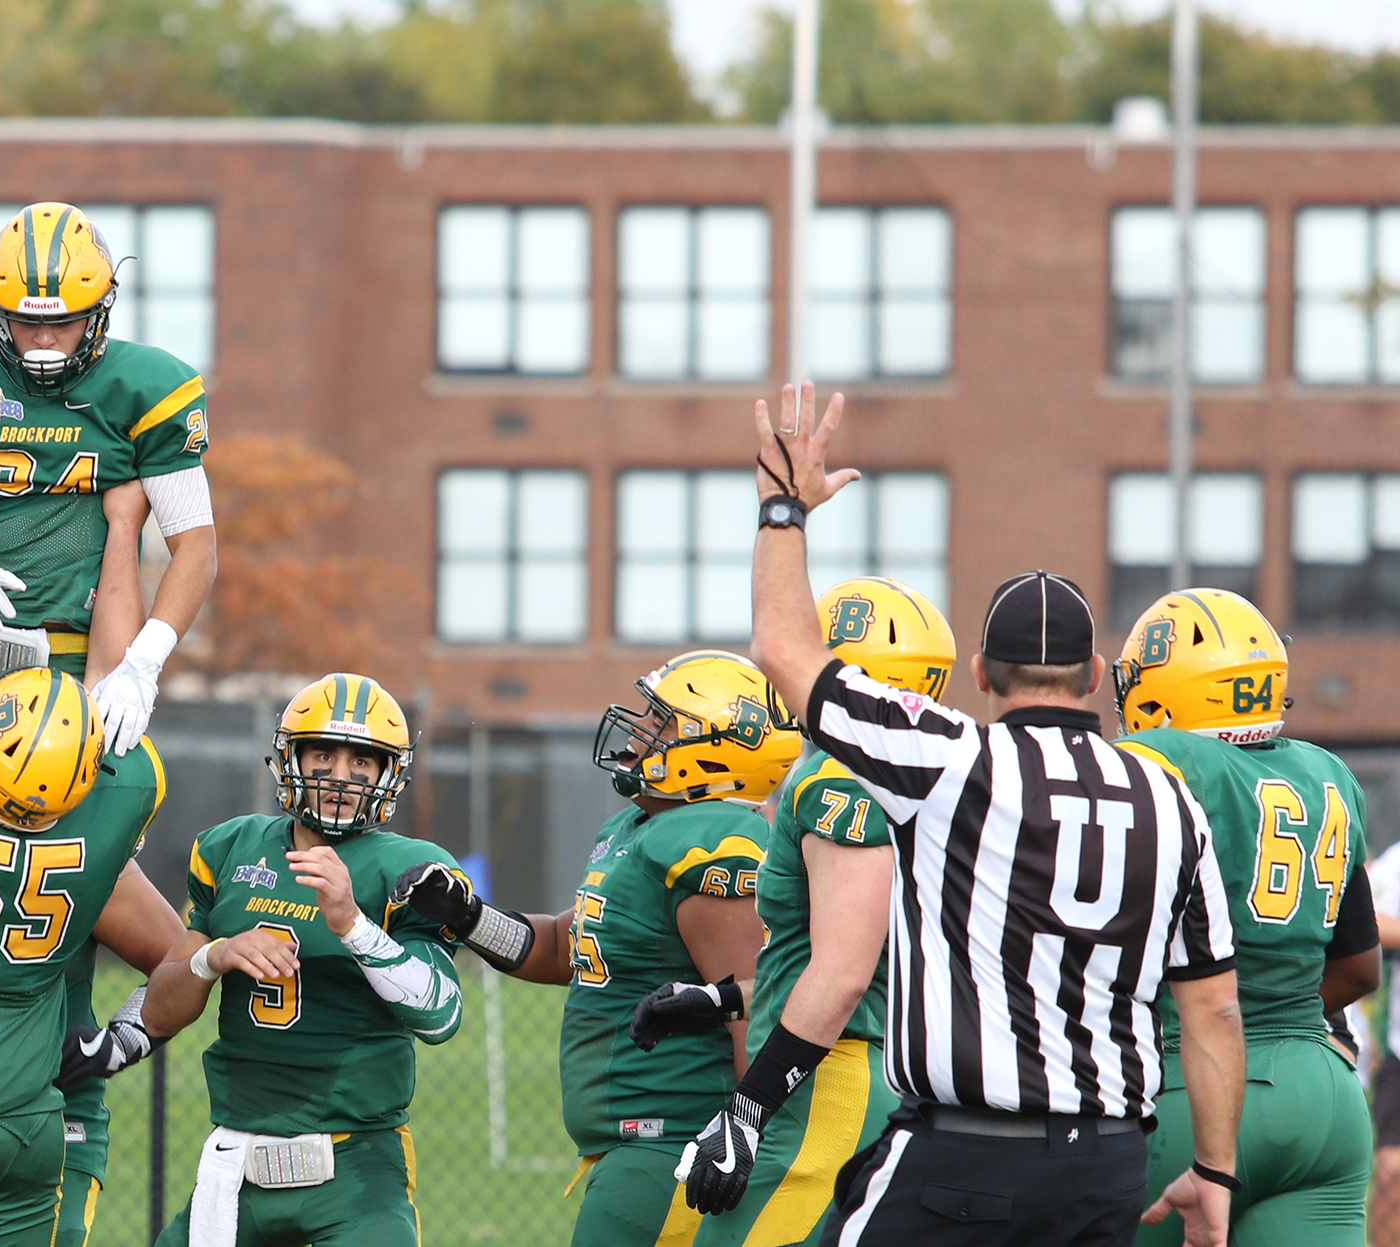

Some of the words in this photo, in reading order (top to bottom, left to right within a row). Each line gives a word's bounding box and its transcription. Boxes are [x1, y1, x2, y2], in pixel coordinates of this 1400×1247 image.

[24, 300, 59, 310] Riddell
[0, 426, 81, 443] BROCKPORT
[829, 594, 876, 643] B
[1139, 616, 1177, 669] B
[925, 667, 947, 702] 71
[1232, 674, 1273, 714] 64
[330, 722, 366, 735] Riddell
[815, 788, 872, 843] 71
[1049, 795, 1135, 930] U
[1246, 778, 1352, 927] 64
[245, 896, 320, 922] BROCKPORT
[249, 921, 302, 1030] 9
[642, 1122, 654, 1130] XL
